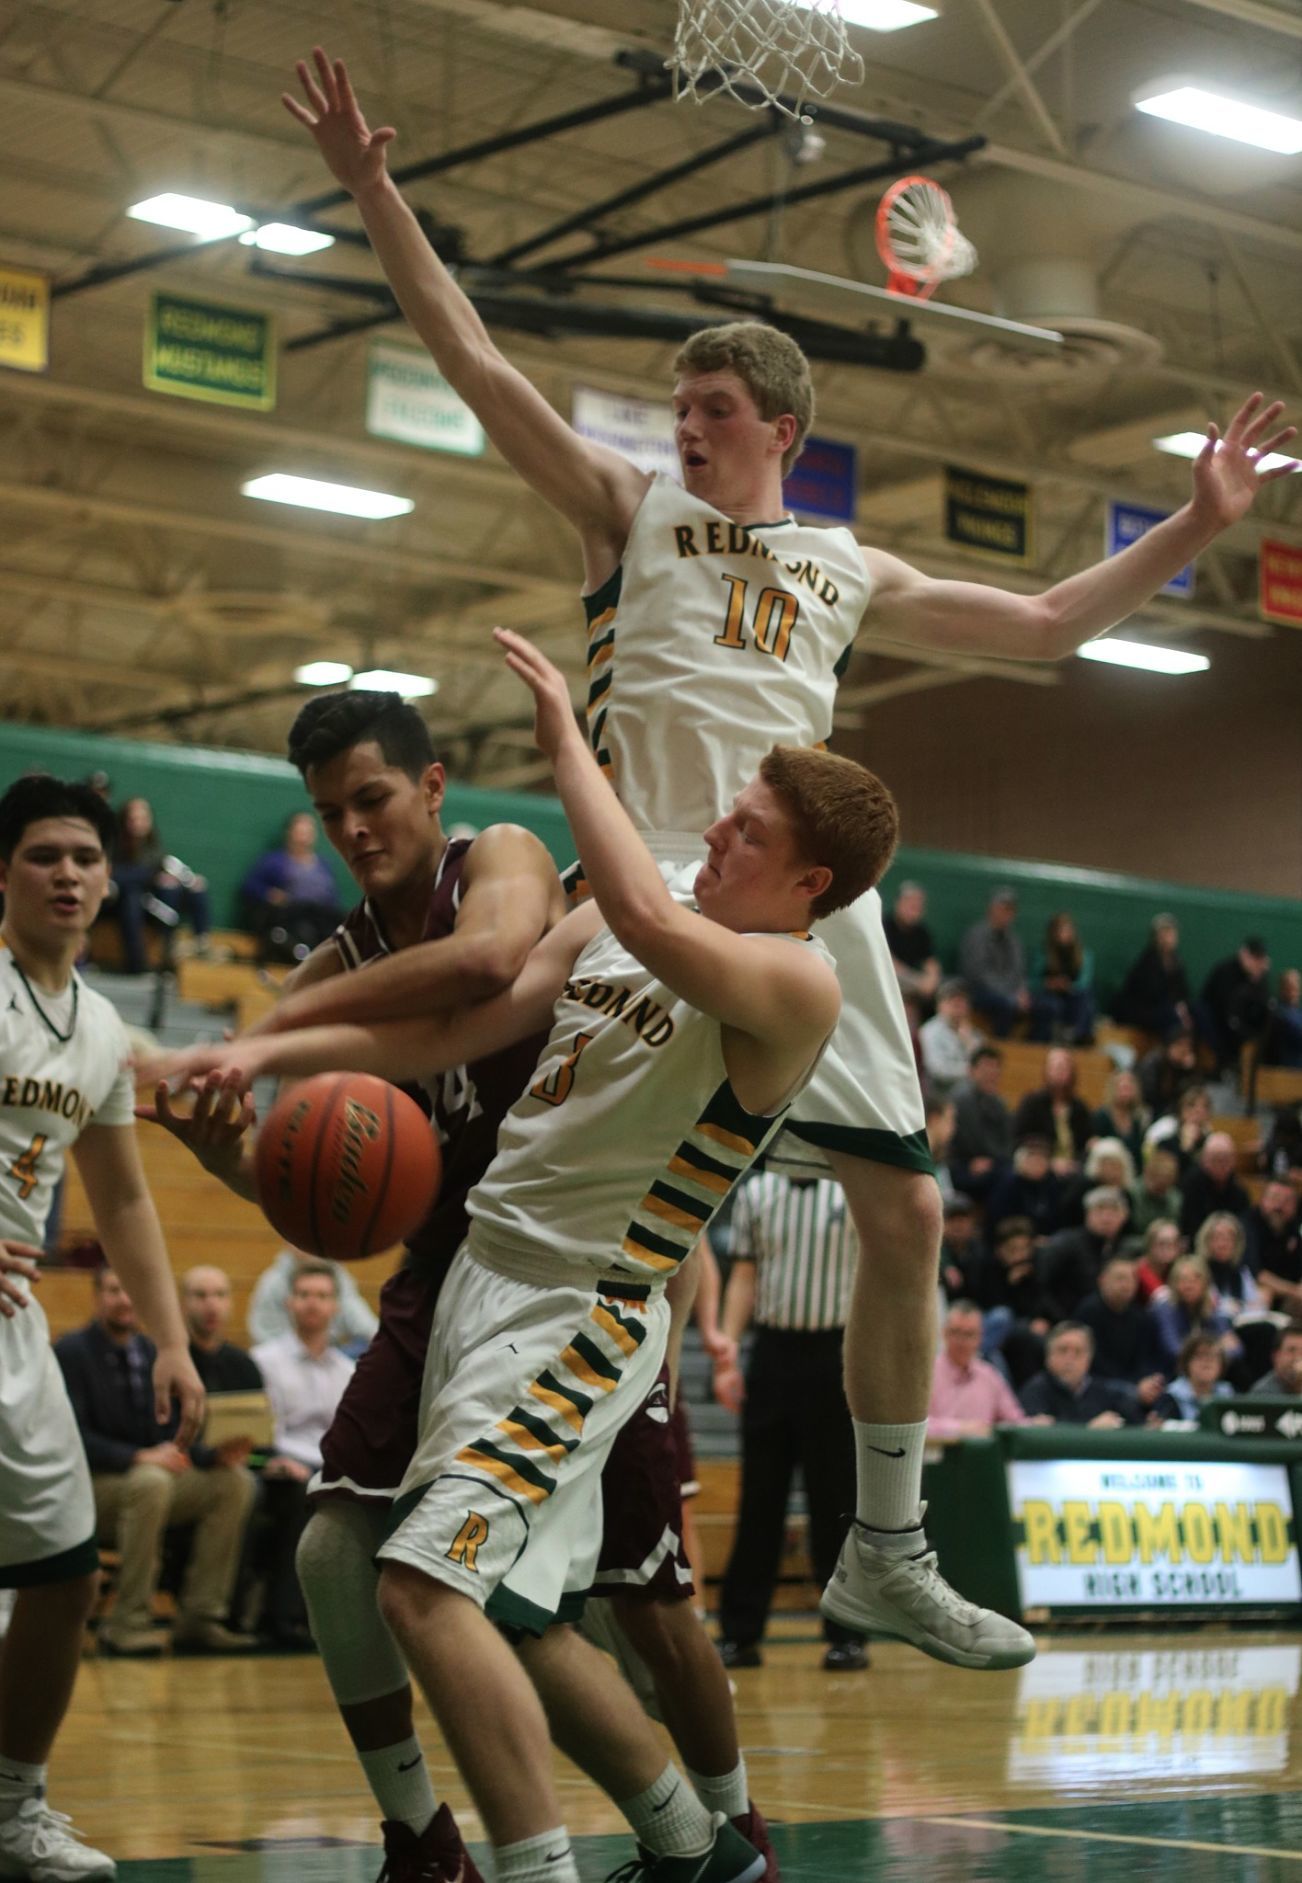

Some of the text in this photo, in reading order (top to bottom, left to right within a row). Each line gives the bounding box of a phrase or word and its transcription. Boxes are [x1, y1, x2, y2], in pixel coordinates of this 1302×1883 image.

[713, 572, 799, 663] 10
[2, 1076, 95, 1129] EDMON
[6, 1132, 48, 1199] 4
[444, 1509, 490, 1574] R
[1021, 1500, 1292, 1566] REDMOND
[1084, 1571, 1244, 1598] HIGH SCHOOL
